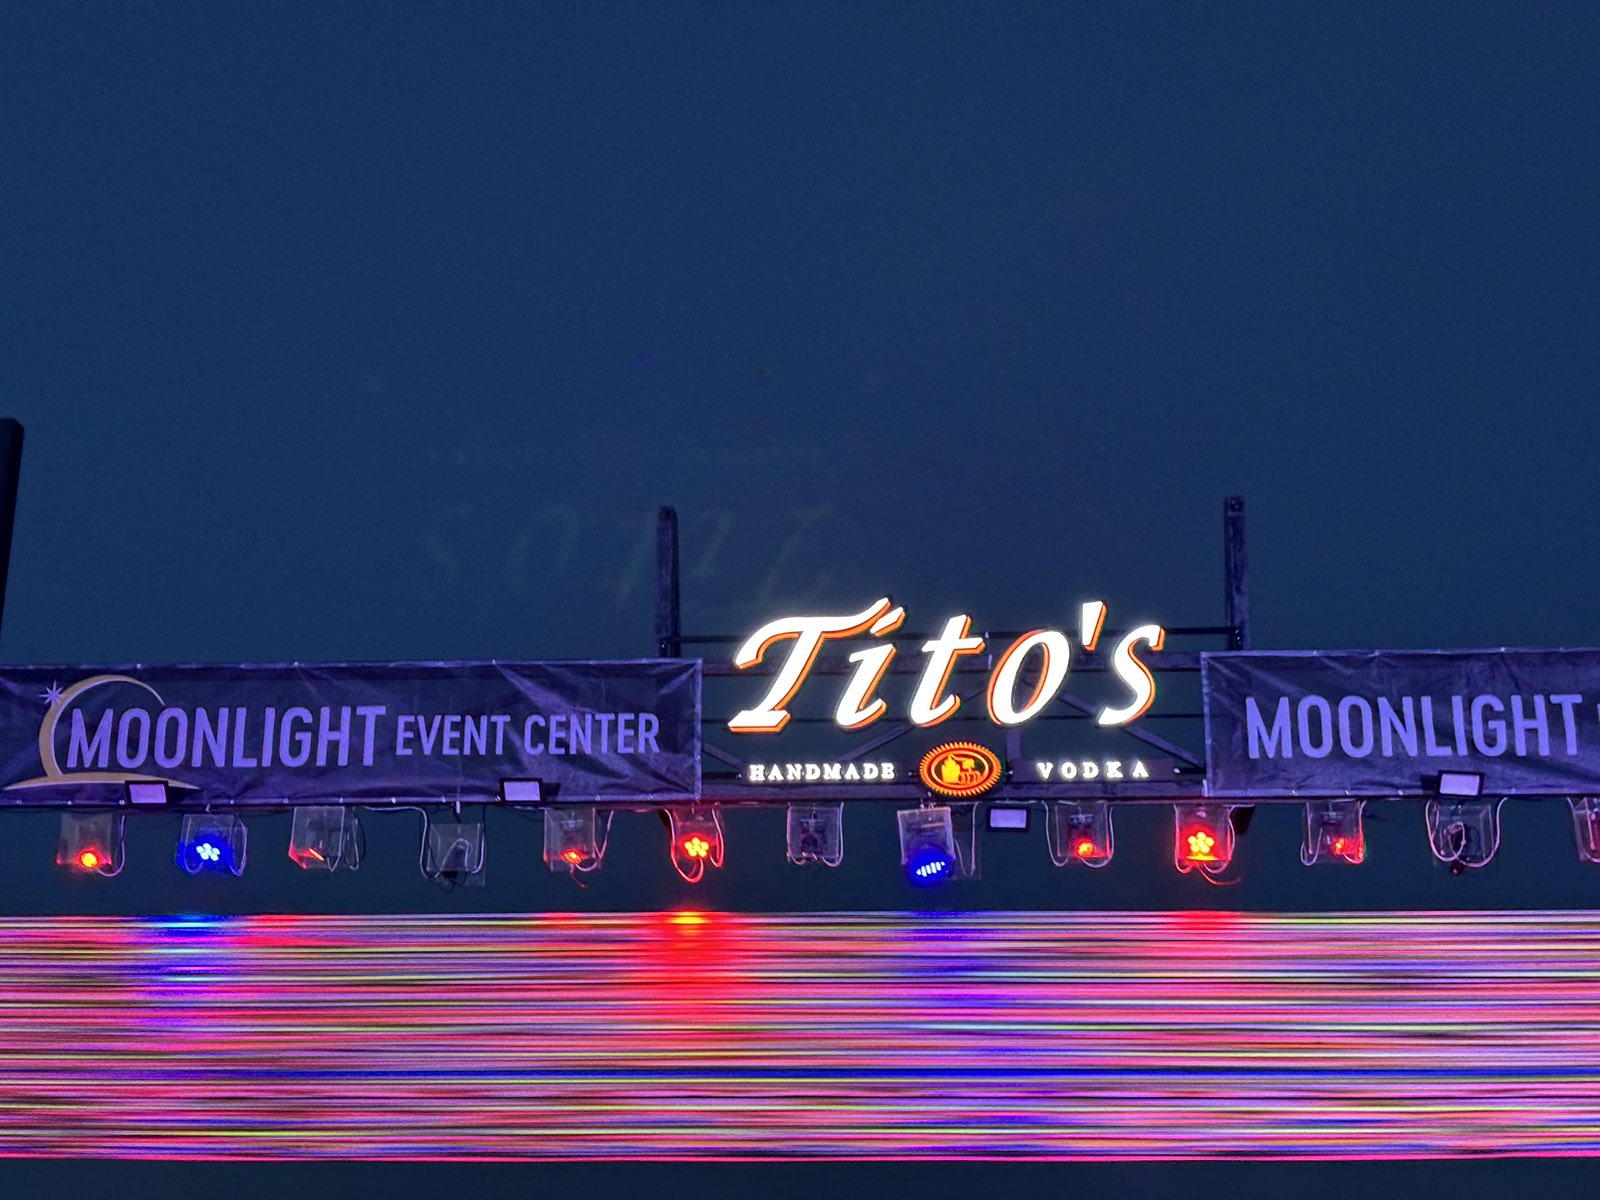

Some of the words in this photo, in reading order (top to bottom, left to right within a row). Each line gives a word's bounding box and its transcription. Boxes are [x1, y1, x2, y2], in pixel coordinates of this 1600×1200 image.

[727, 597, 1166, 733] Tito's
[66, 705, 386, 769] MOONLIGHT
[396, 714, 511, 756] EVENT
[523, 712, 660, 756] CENTER
[1245, 694, 1582, 759] MOONLIGHT
[749, 762, 895, 781] HANDMADE
[1037, 760, 1149, 779] VODKA
